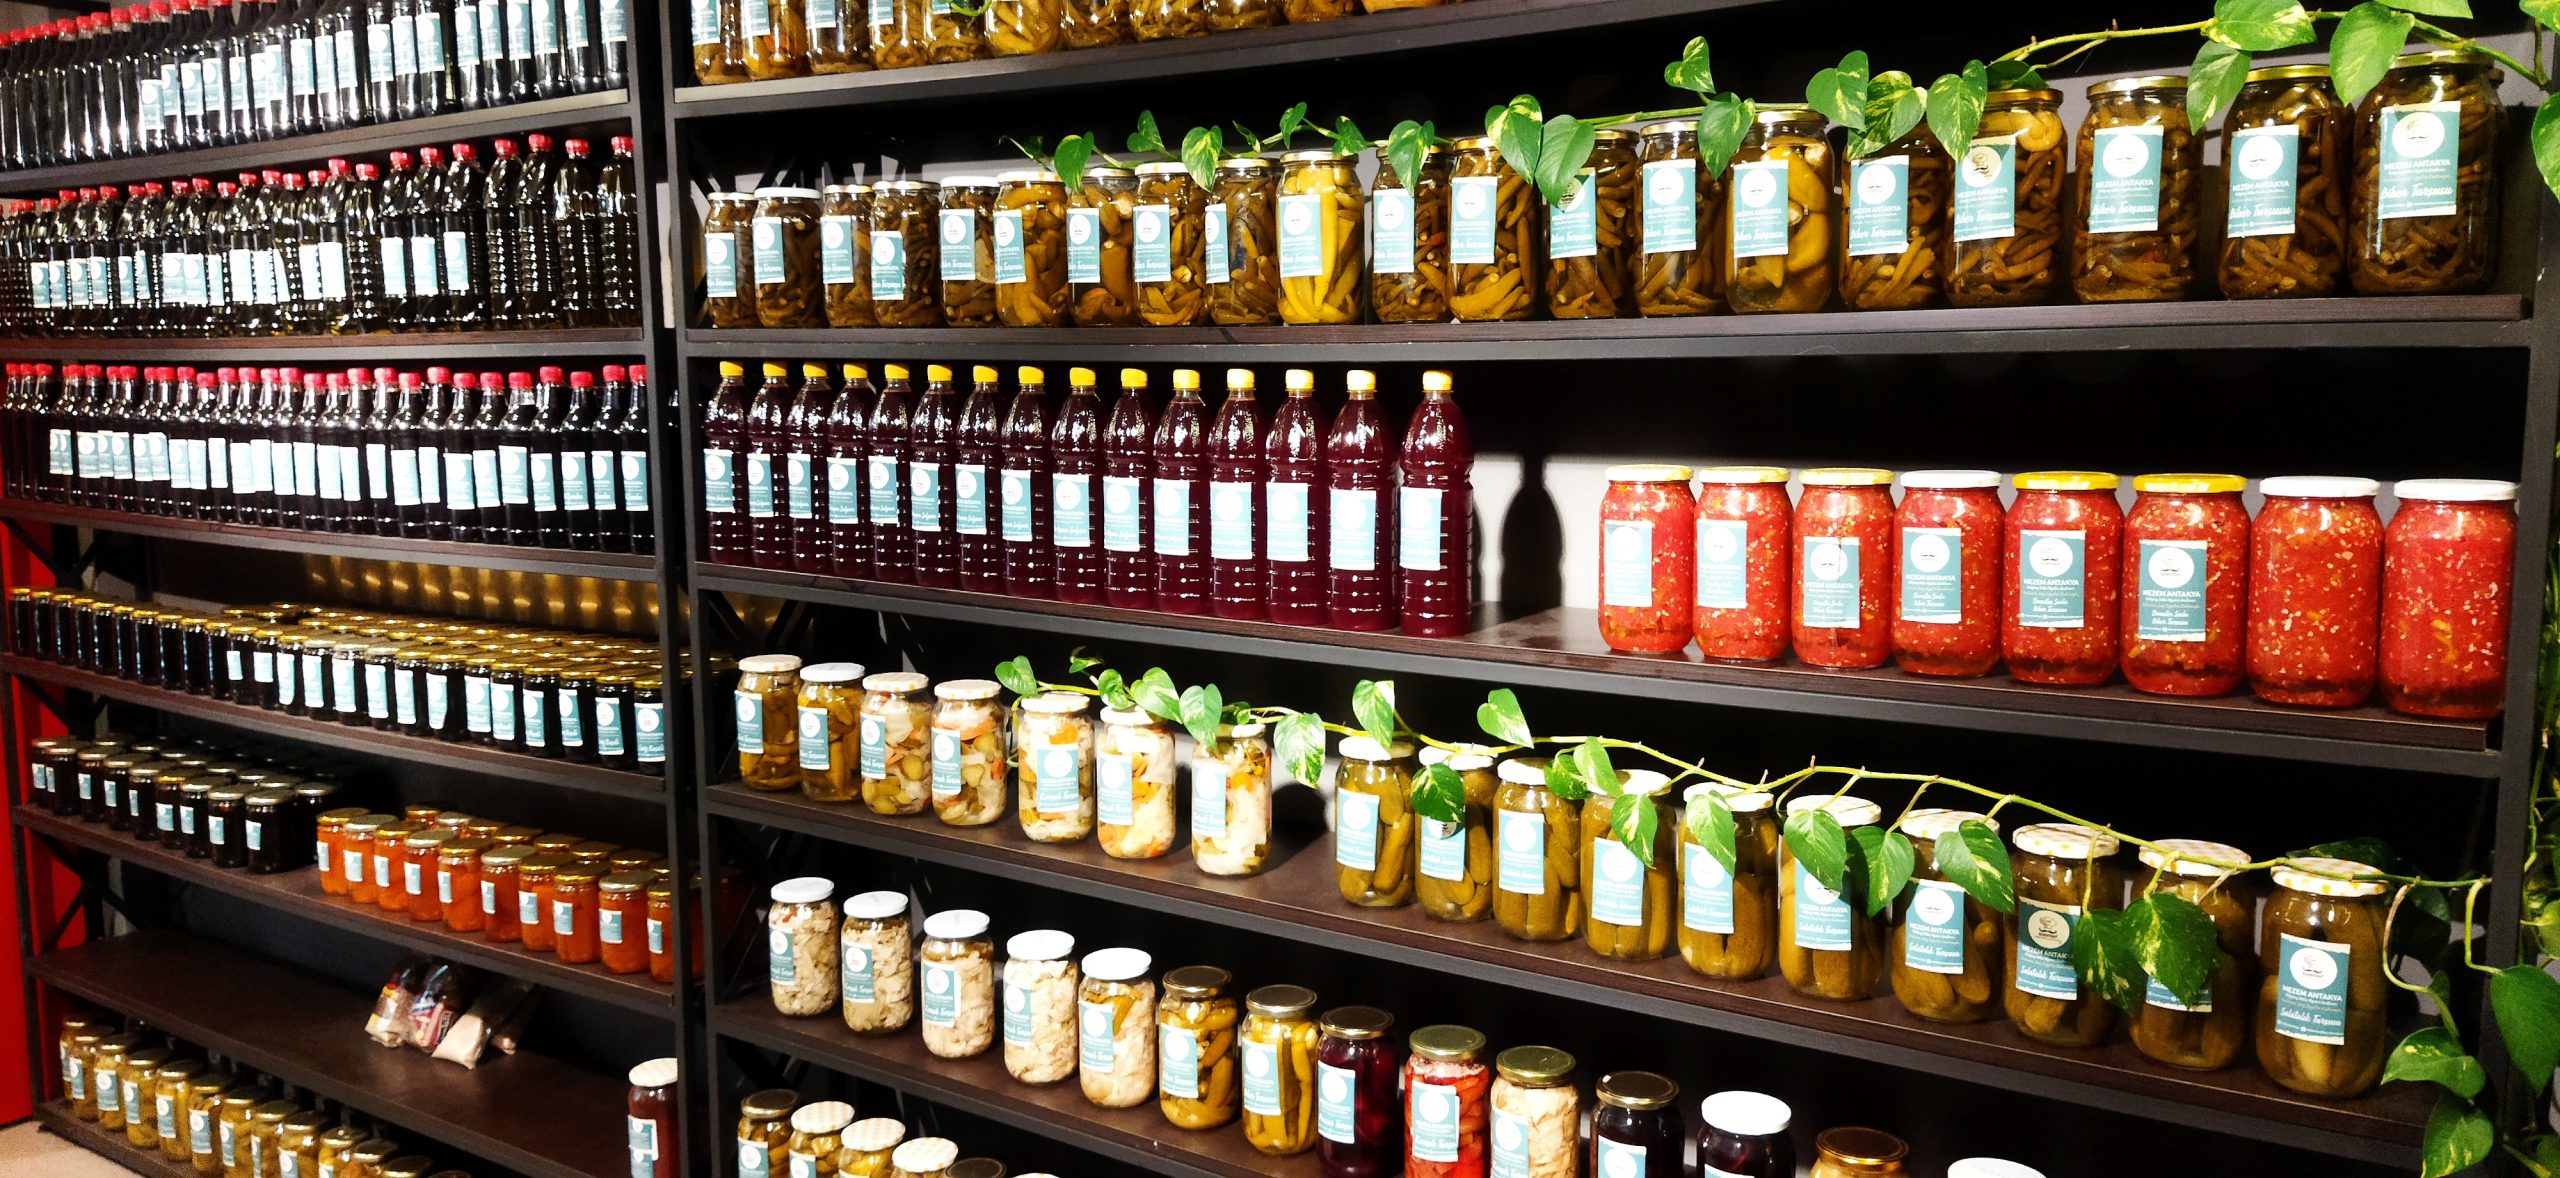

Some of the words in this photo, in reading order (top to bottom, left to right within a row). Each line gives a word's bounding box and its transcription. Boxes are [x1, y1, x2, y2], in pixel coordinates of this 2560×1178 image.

[2413, 159, 2450, 168] ANTAKYA
[2255, 180, 2288, 189] ANTAKYA
[2307, 991, 2342, 1002] ANTAKYA
